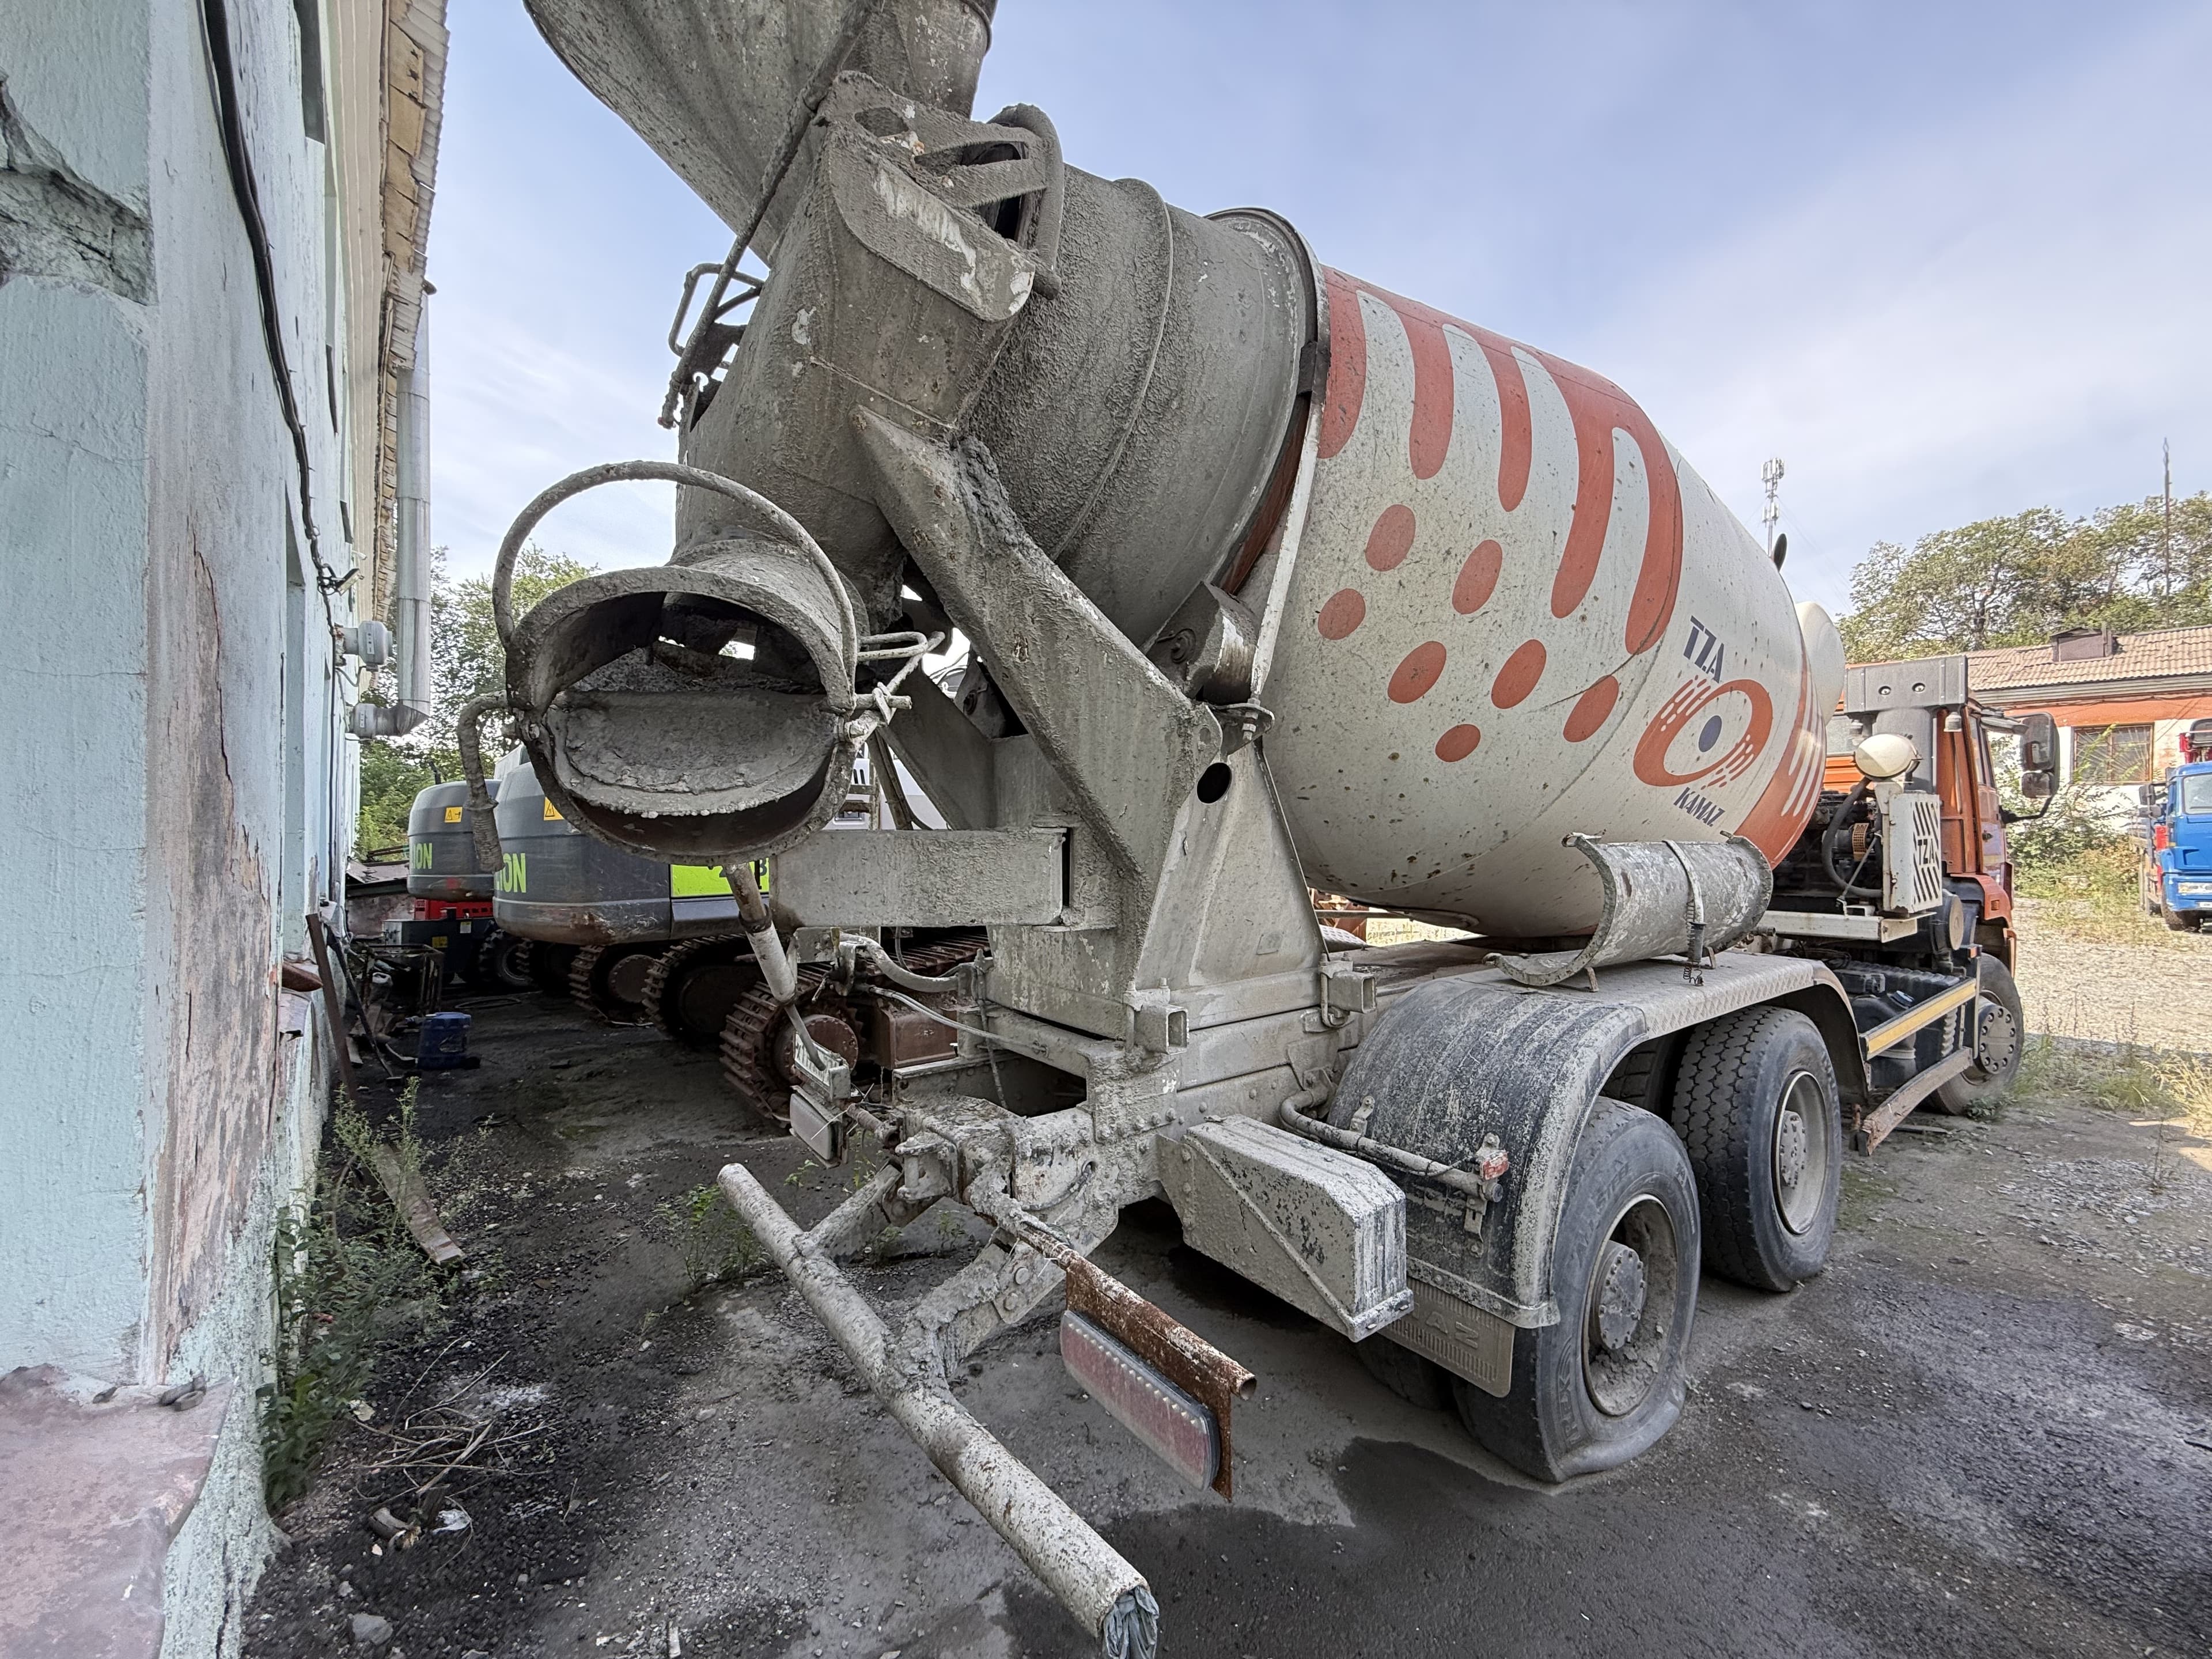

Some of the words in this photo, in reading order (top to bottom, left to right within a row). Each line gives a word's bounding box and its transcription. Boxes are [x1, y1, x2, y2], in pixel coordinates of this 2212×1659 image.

[1683, 615, 1725, 684] TZA
[1673, 787, 1726, 827] KAMAZ
[1918, 838, 1935, 866] TZA
